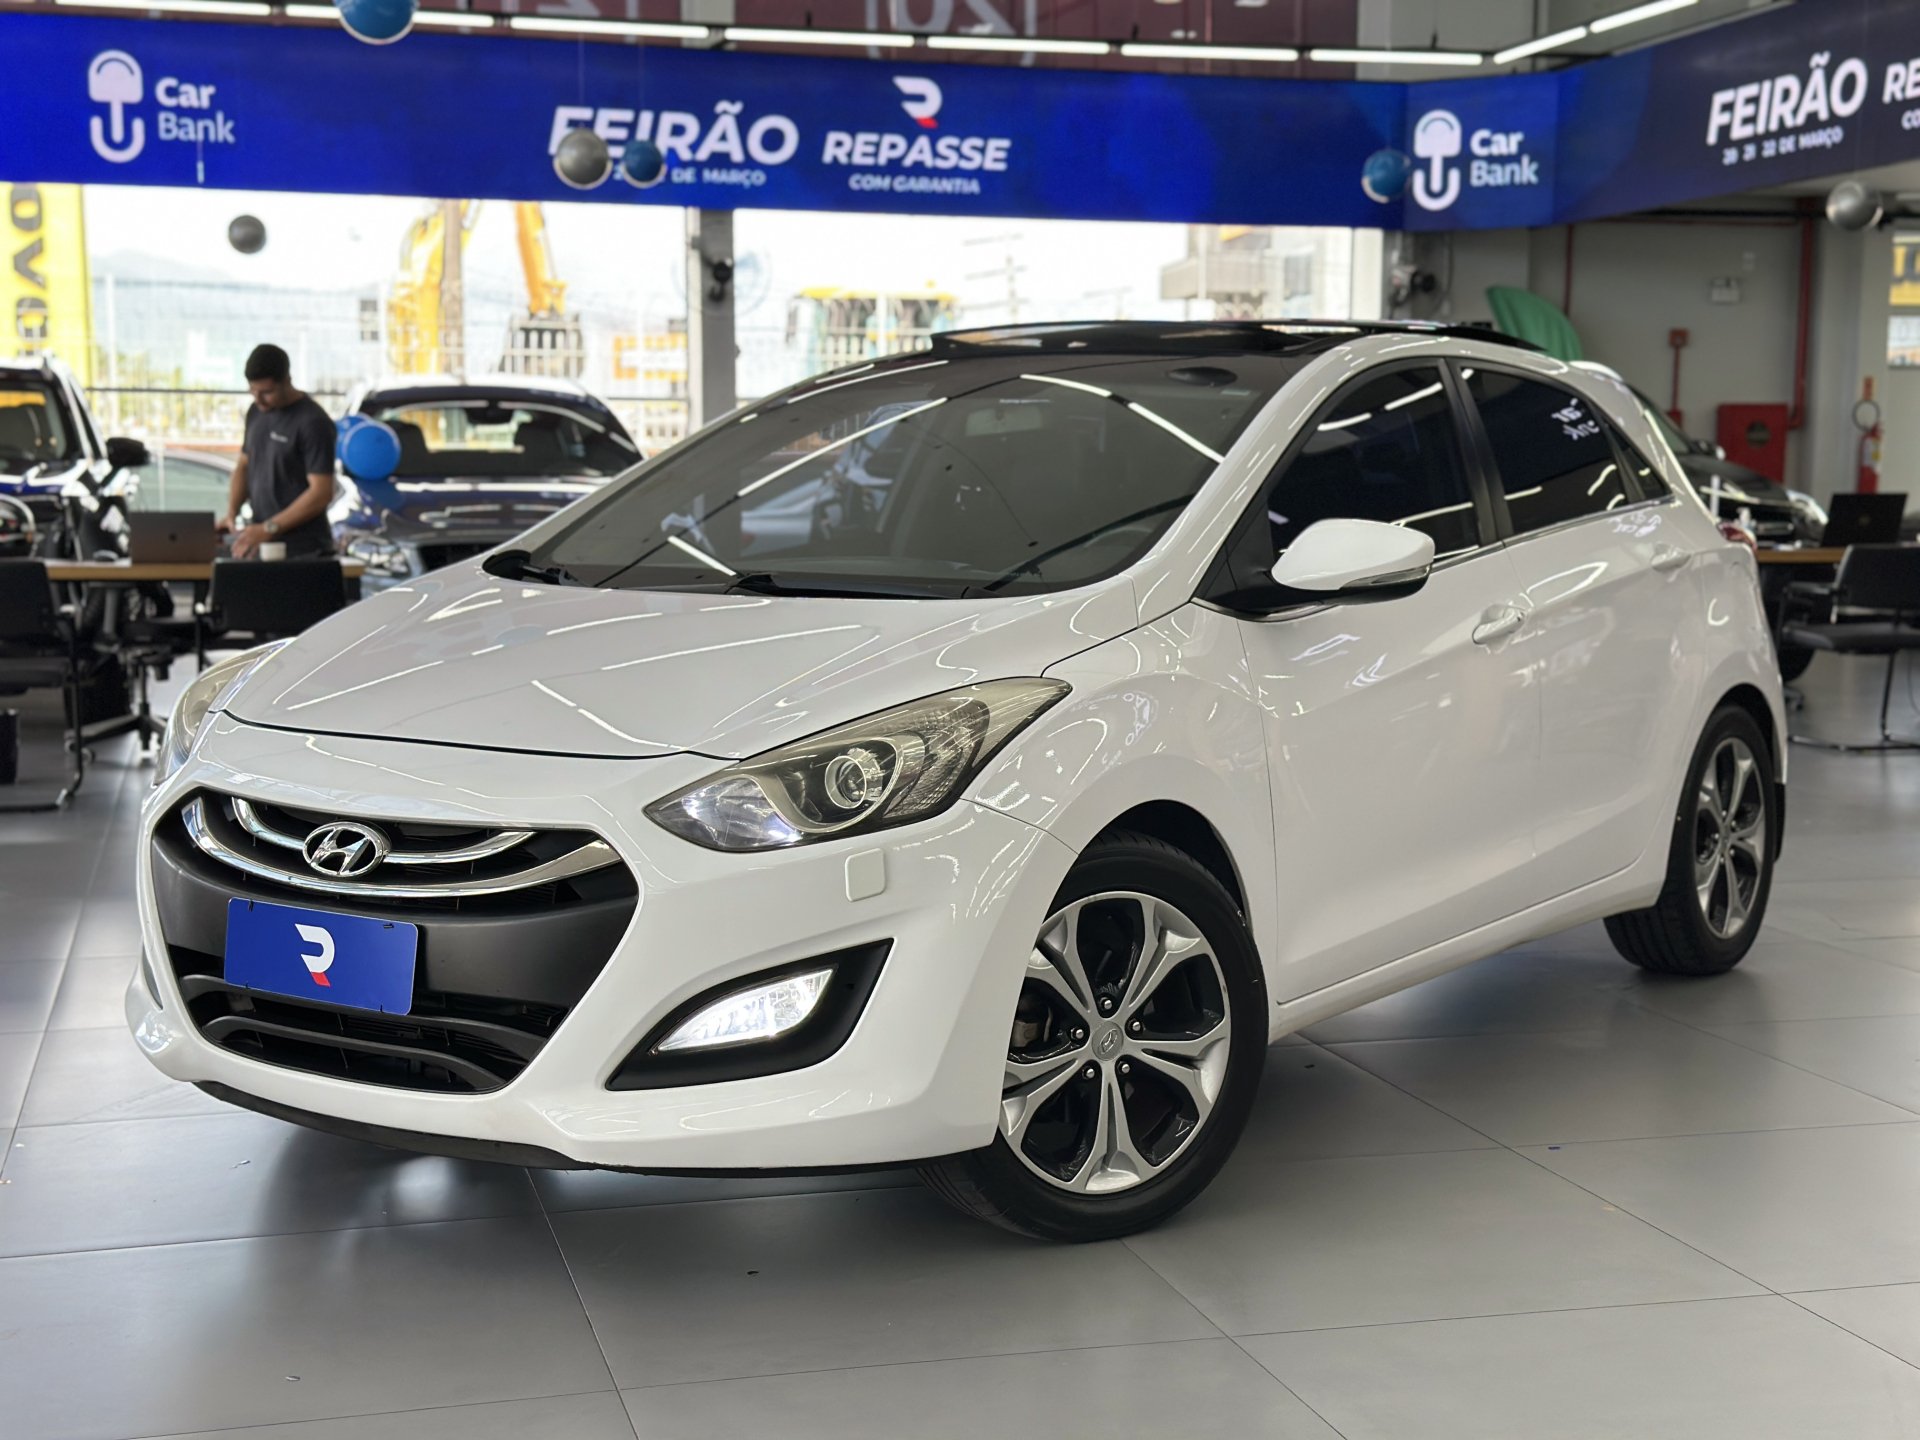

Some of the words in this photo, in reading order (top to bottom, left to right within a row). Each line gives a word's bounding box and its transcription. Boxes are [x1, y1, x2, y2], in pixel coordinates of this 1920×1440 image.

[155, 76, 216, 109] Car
[1706, 51, 1869, 146] FEIRÃO
[157, 110, 236, 144] Bank
[548, 100, 799, 166] FEIRÃO
[1470, 129, 1524, 157] Car
[1778, 134, 1796, 154] DE
[1798, 125, 1844, 149] MARÇO
[822, 131, 1012, 172] REPASSE
[671, 166, 697, 184] DE
[702, 168, 767, 189] MARÇO
[848, 173, 892, 191] COM
[892, 175, 981, 195] GARANTIA
[1469, 154, 1539, 187] Bank
